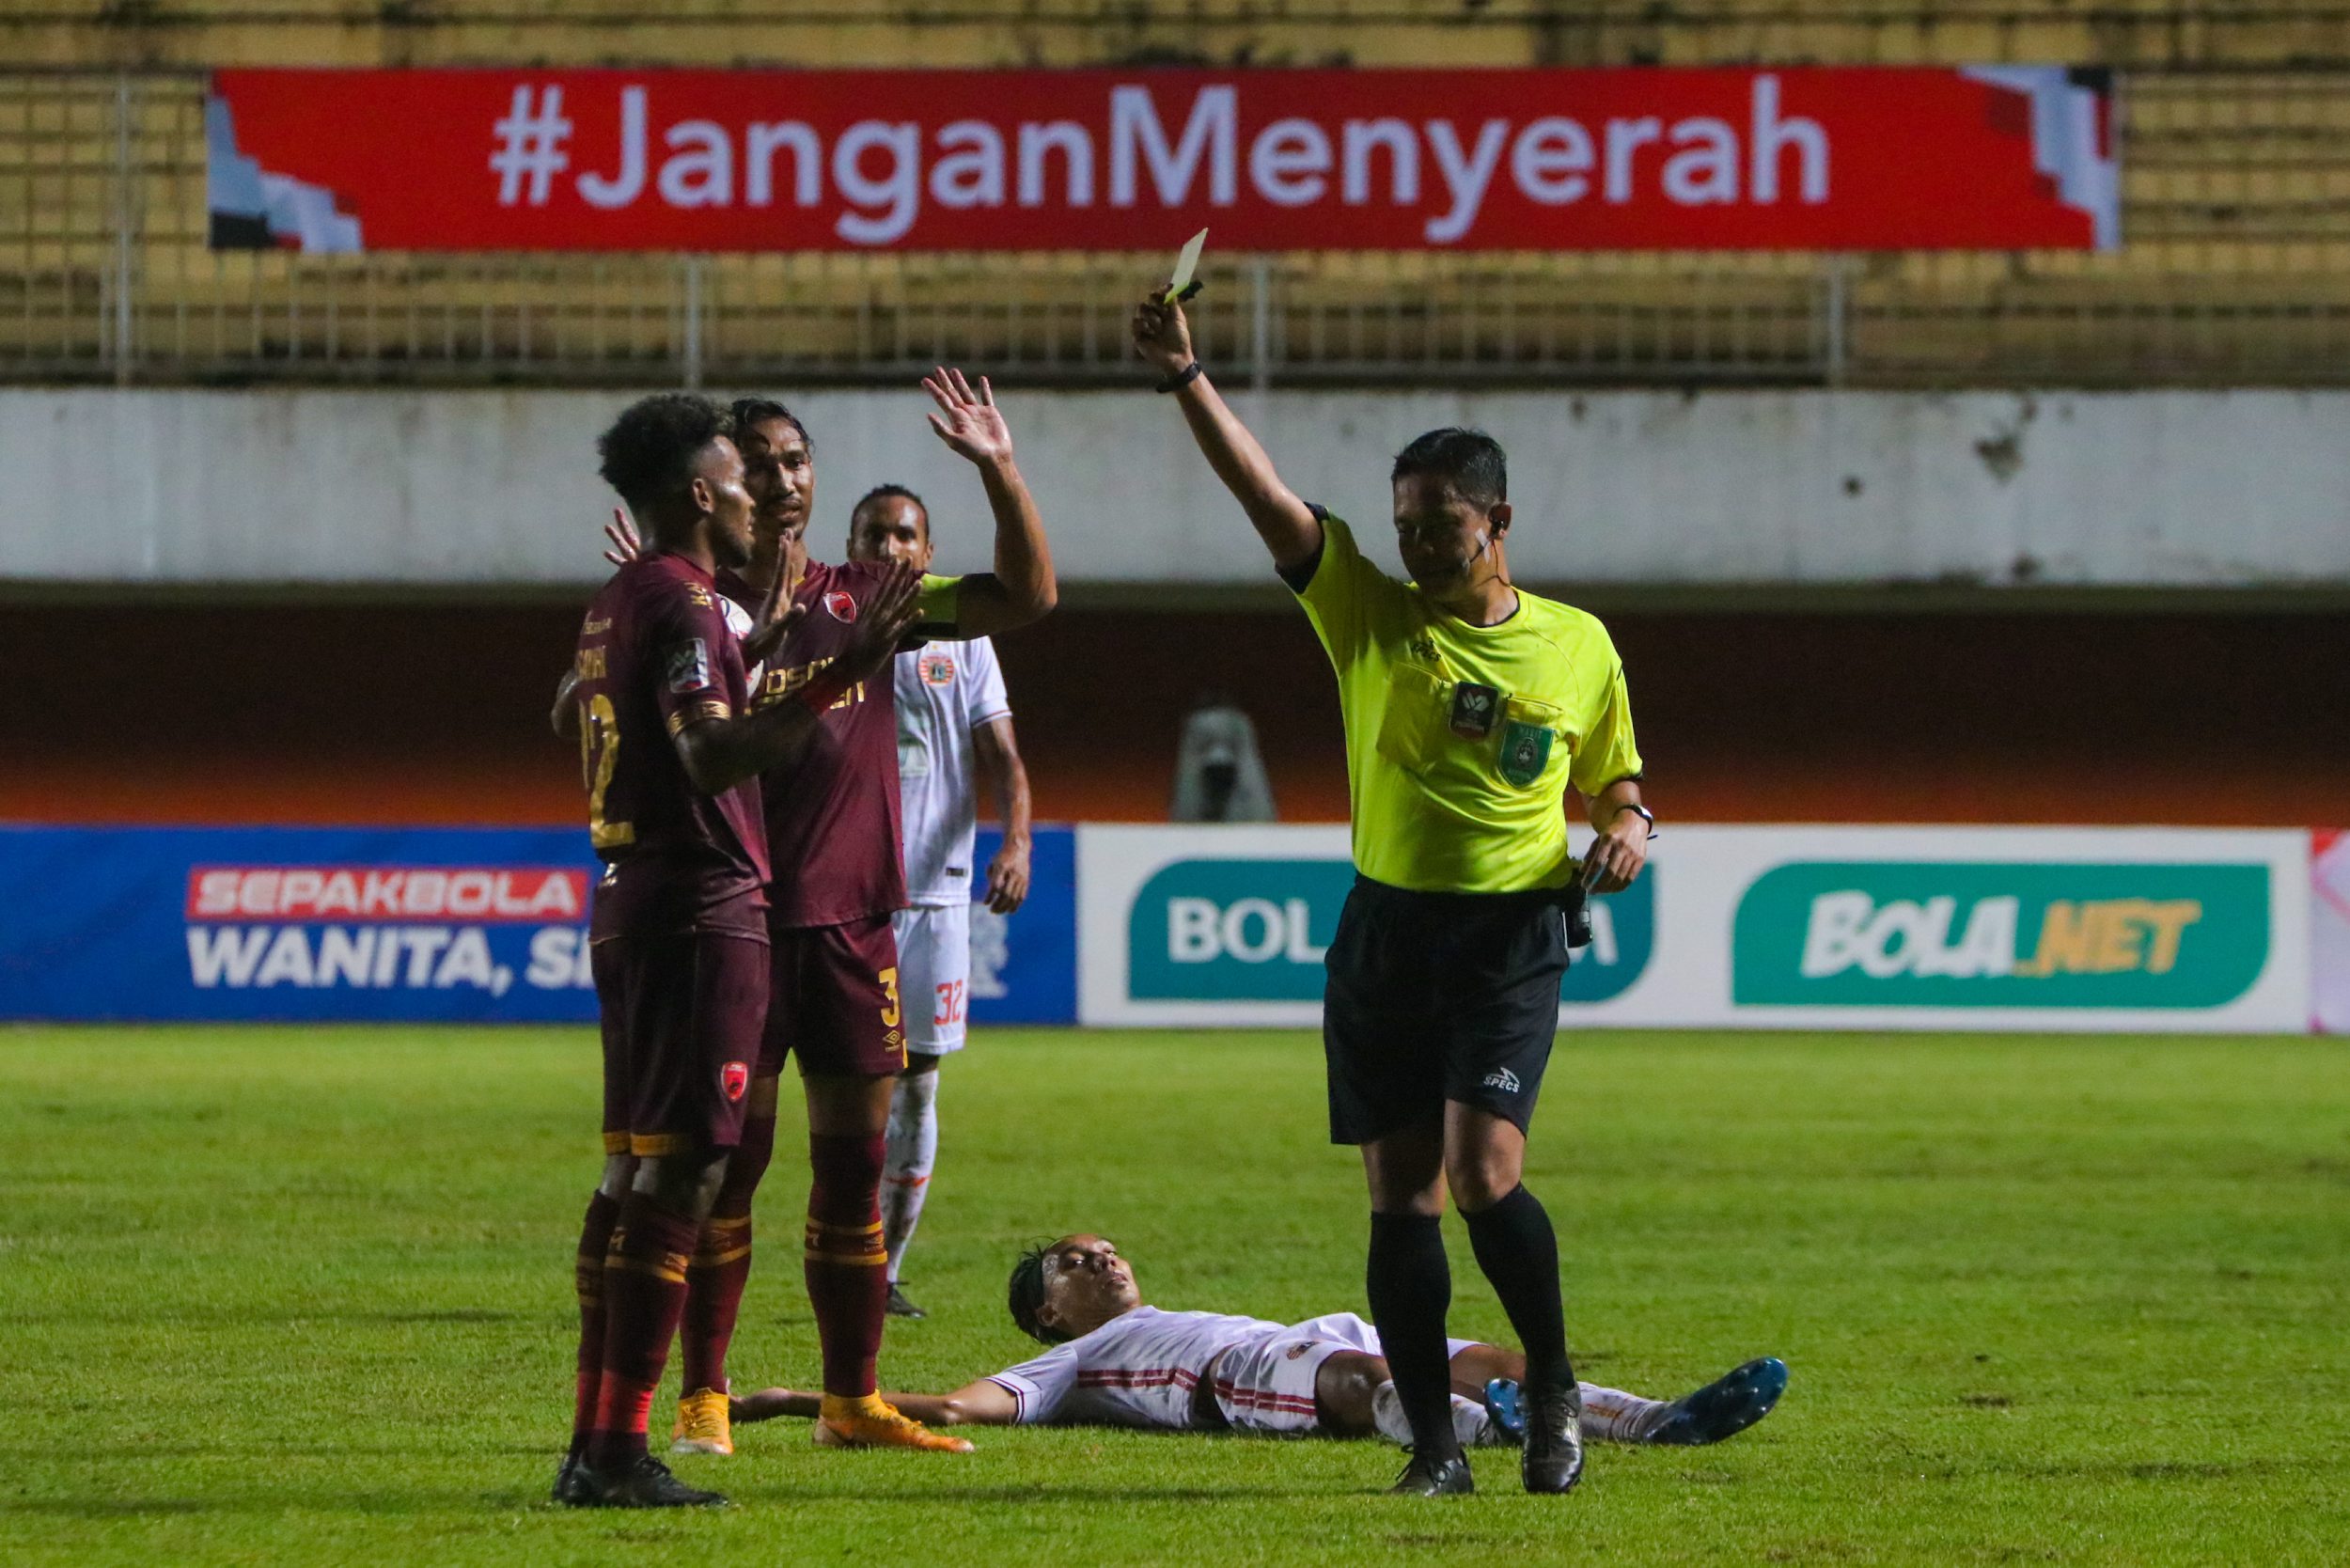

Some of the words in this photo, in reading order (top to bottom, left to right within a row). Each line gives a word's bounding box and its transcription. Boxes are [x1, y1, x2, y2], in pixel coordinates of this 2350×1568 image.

[490, 77, 1830, 245] #JanganMenyerah
[195, 870, 579, 915] SEPAKBOLA
[1167, 897, 1328, 964] BOL
[187, 925, 513, 998] WANITA,
[879, 966, 900, 1027] 3
[933, 979, 964, 1026] 32
[1483, 1075, 1520, 1093] SPECS
